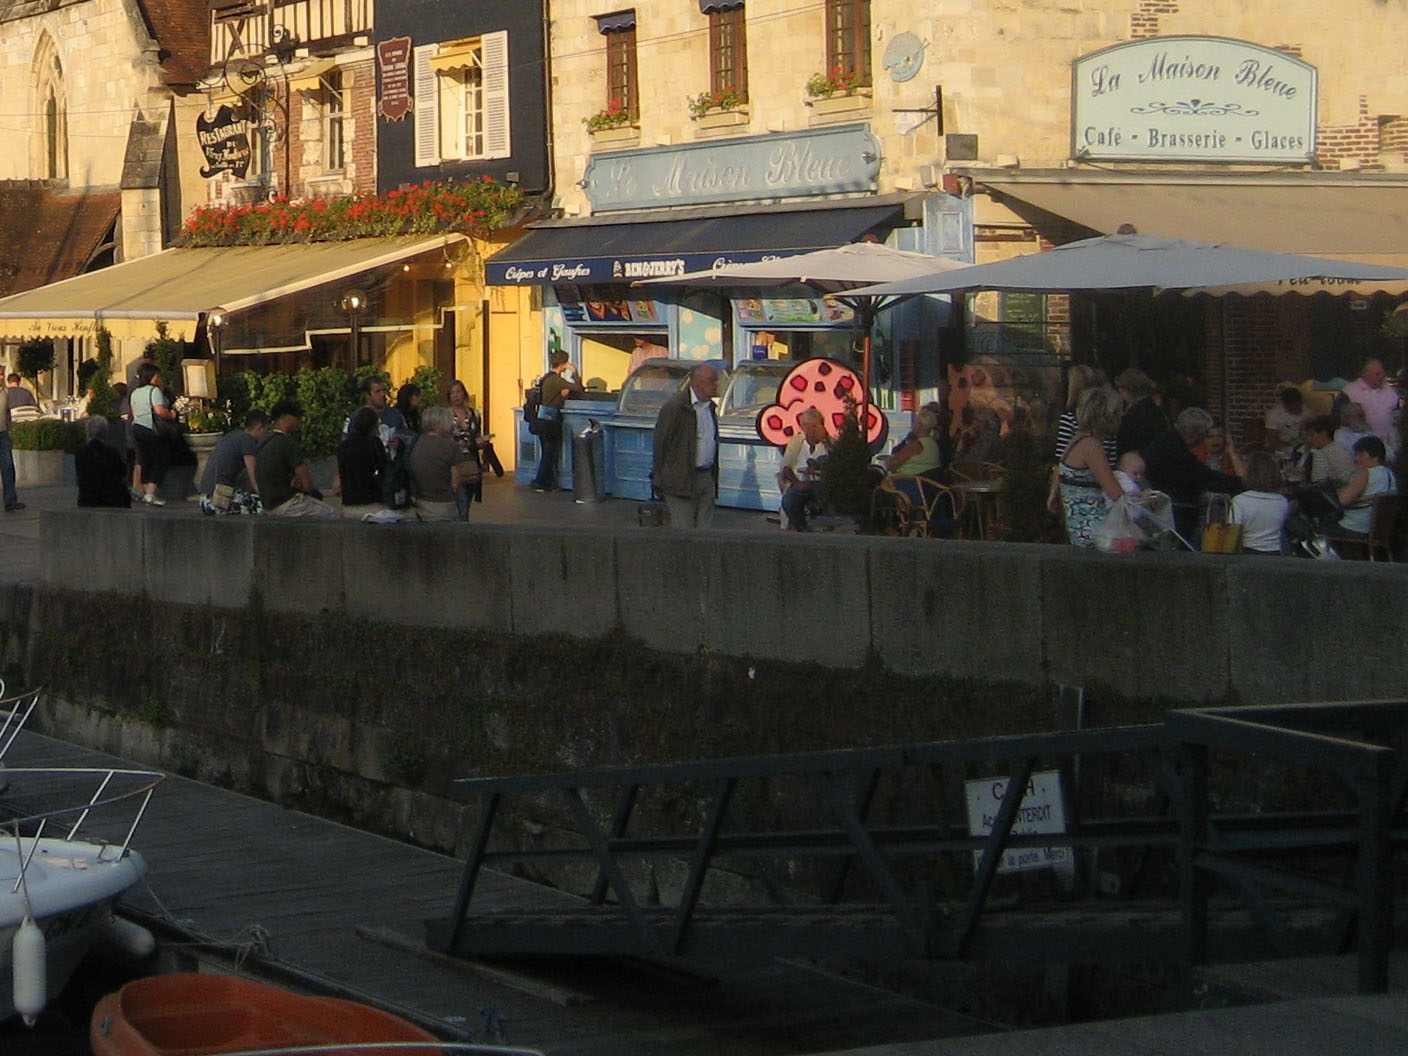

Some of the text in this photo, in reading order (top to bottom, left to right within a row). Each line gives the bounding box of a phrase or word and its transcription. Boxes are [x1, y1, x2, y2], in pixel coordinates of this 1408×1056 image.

[1091, 51, 1298, 100] La Maison Bleue
[1084, 126, 1122, 147] Café
[1148, 128, 1227, 149] Brasserie
[1251, 130, 1305, 150] Glaces
[765, 141, 852, 187] Bleue
[537, 269, 548, 279] et
[550, 263, 591, 281] Gaufres
